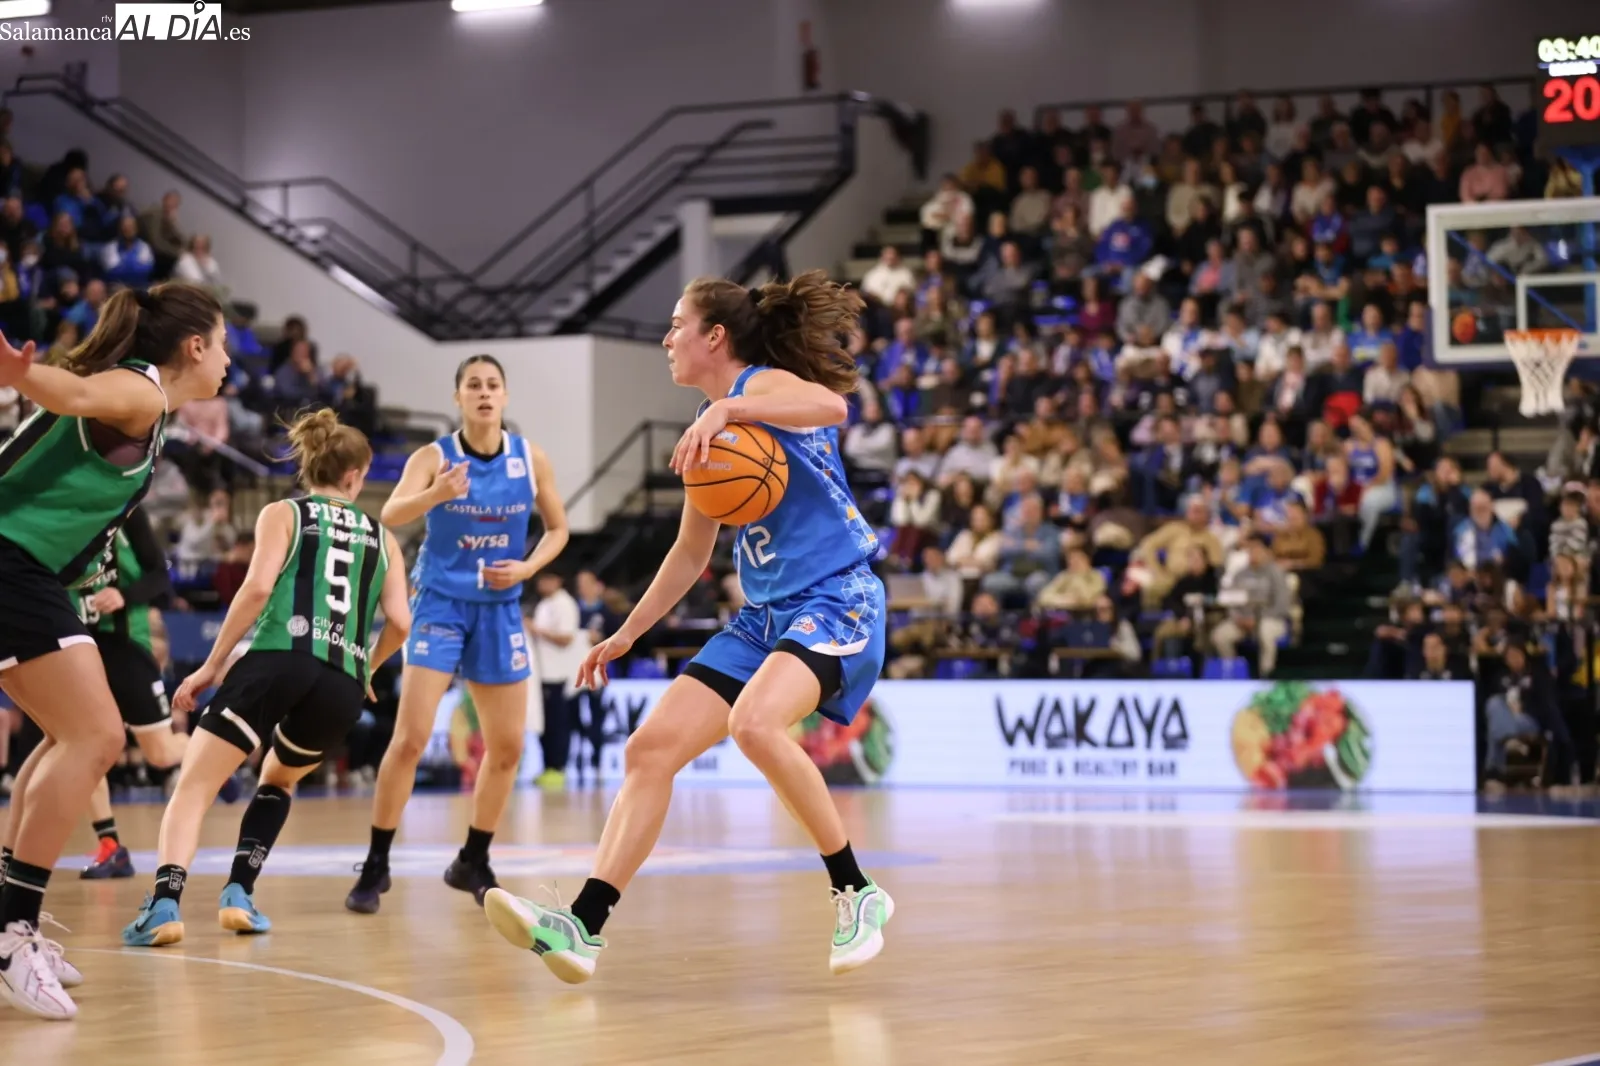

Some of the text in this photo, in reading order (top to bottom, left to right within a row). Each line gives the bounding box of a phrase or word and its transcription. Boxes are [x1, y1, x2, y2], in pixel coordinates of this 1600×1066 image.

[1543, 76, 1600, 123] 20
[445, 503, 492, 514] CASTILLA
[742, 525, 776, 568] 12
[325, 546, 354, 614] 5
[313, 615, 334, 630] City
[994, 693, 1189, 749] WAKAYA
[1149, 759, 1177, 776] BAR
